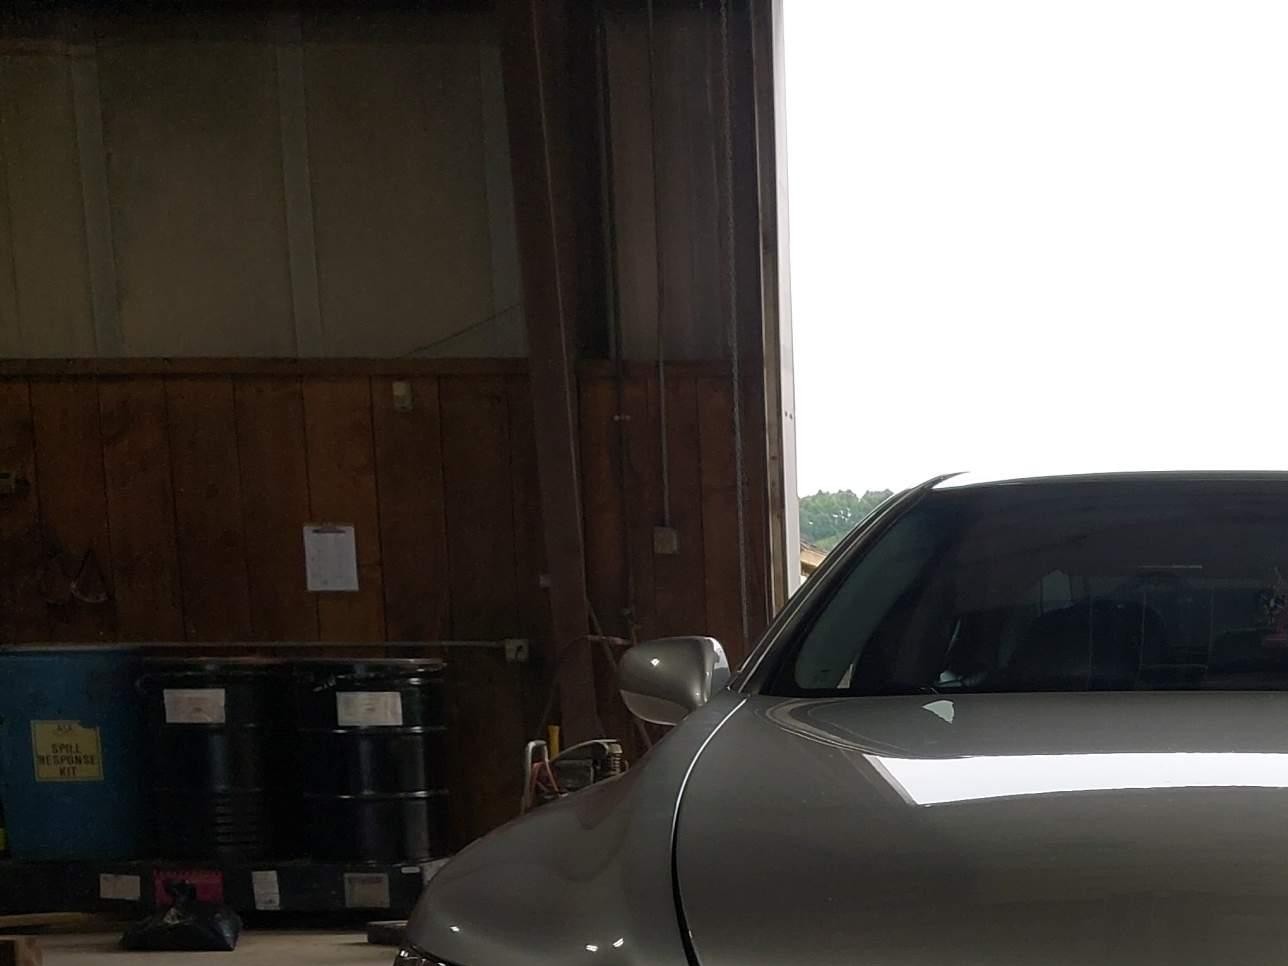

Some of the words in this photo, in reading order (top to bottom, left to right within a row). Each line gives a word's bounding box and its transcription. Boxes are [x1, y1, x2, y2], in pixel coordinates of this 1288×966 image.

[51, 743, 80, 754] SPILL
[38, 754, 96, 766] RESPONSE
[59, 766, 77, 777] KIT
